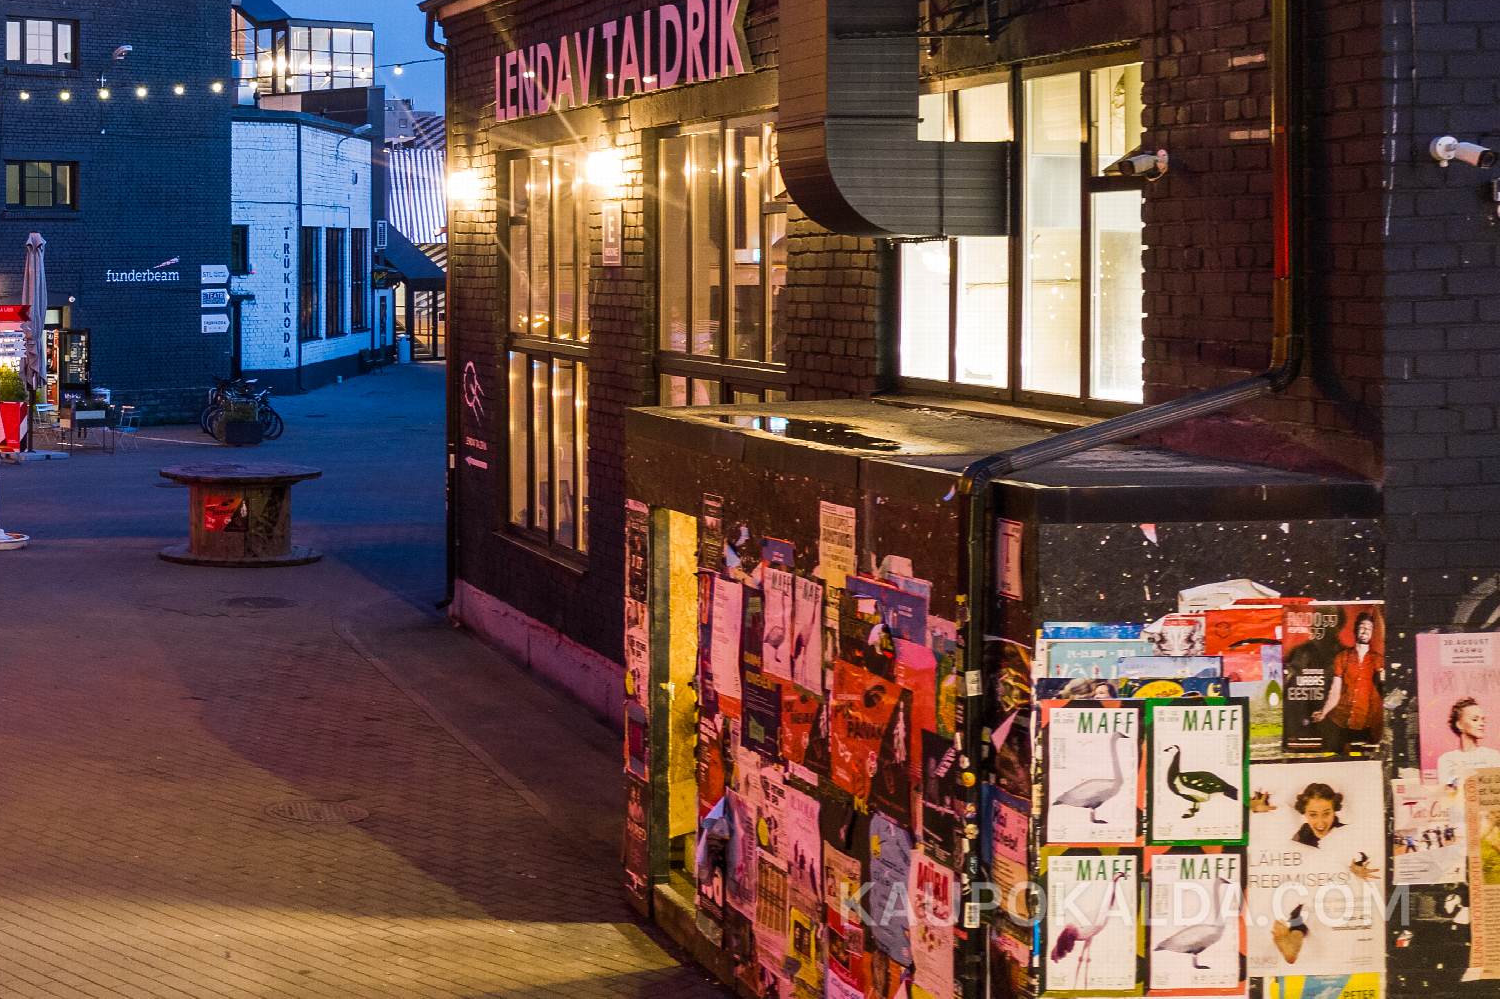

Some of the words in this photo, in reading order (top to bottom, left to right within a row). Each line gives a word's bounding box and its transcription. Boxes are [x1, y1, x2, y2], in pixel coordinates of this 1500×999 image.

[495, 26, 595, 122] LENDAV
[106, 269, 180, 282] funderbeam
[283, 227, 291, 358] TRÜKIKODA
[1077, 711, 1135, 734] MAFF
[1182, 709, 1238, 731] MAFF
[1179, 857, 1236, 880] MAFF
[1249, 850, 1302, 867] LÄHEB
[1076, 859, 1133, 881] MAFF
